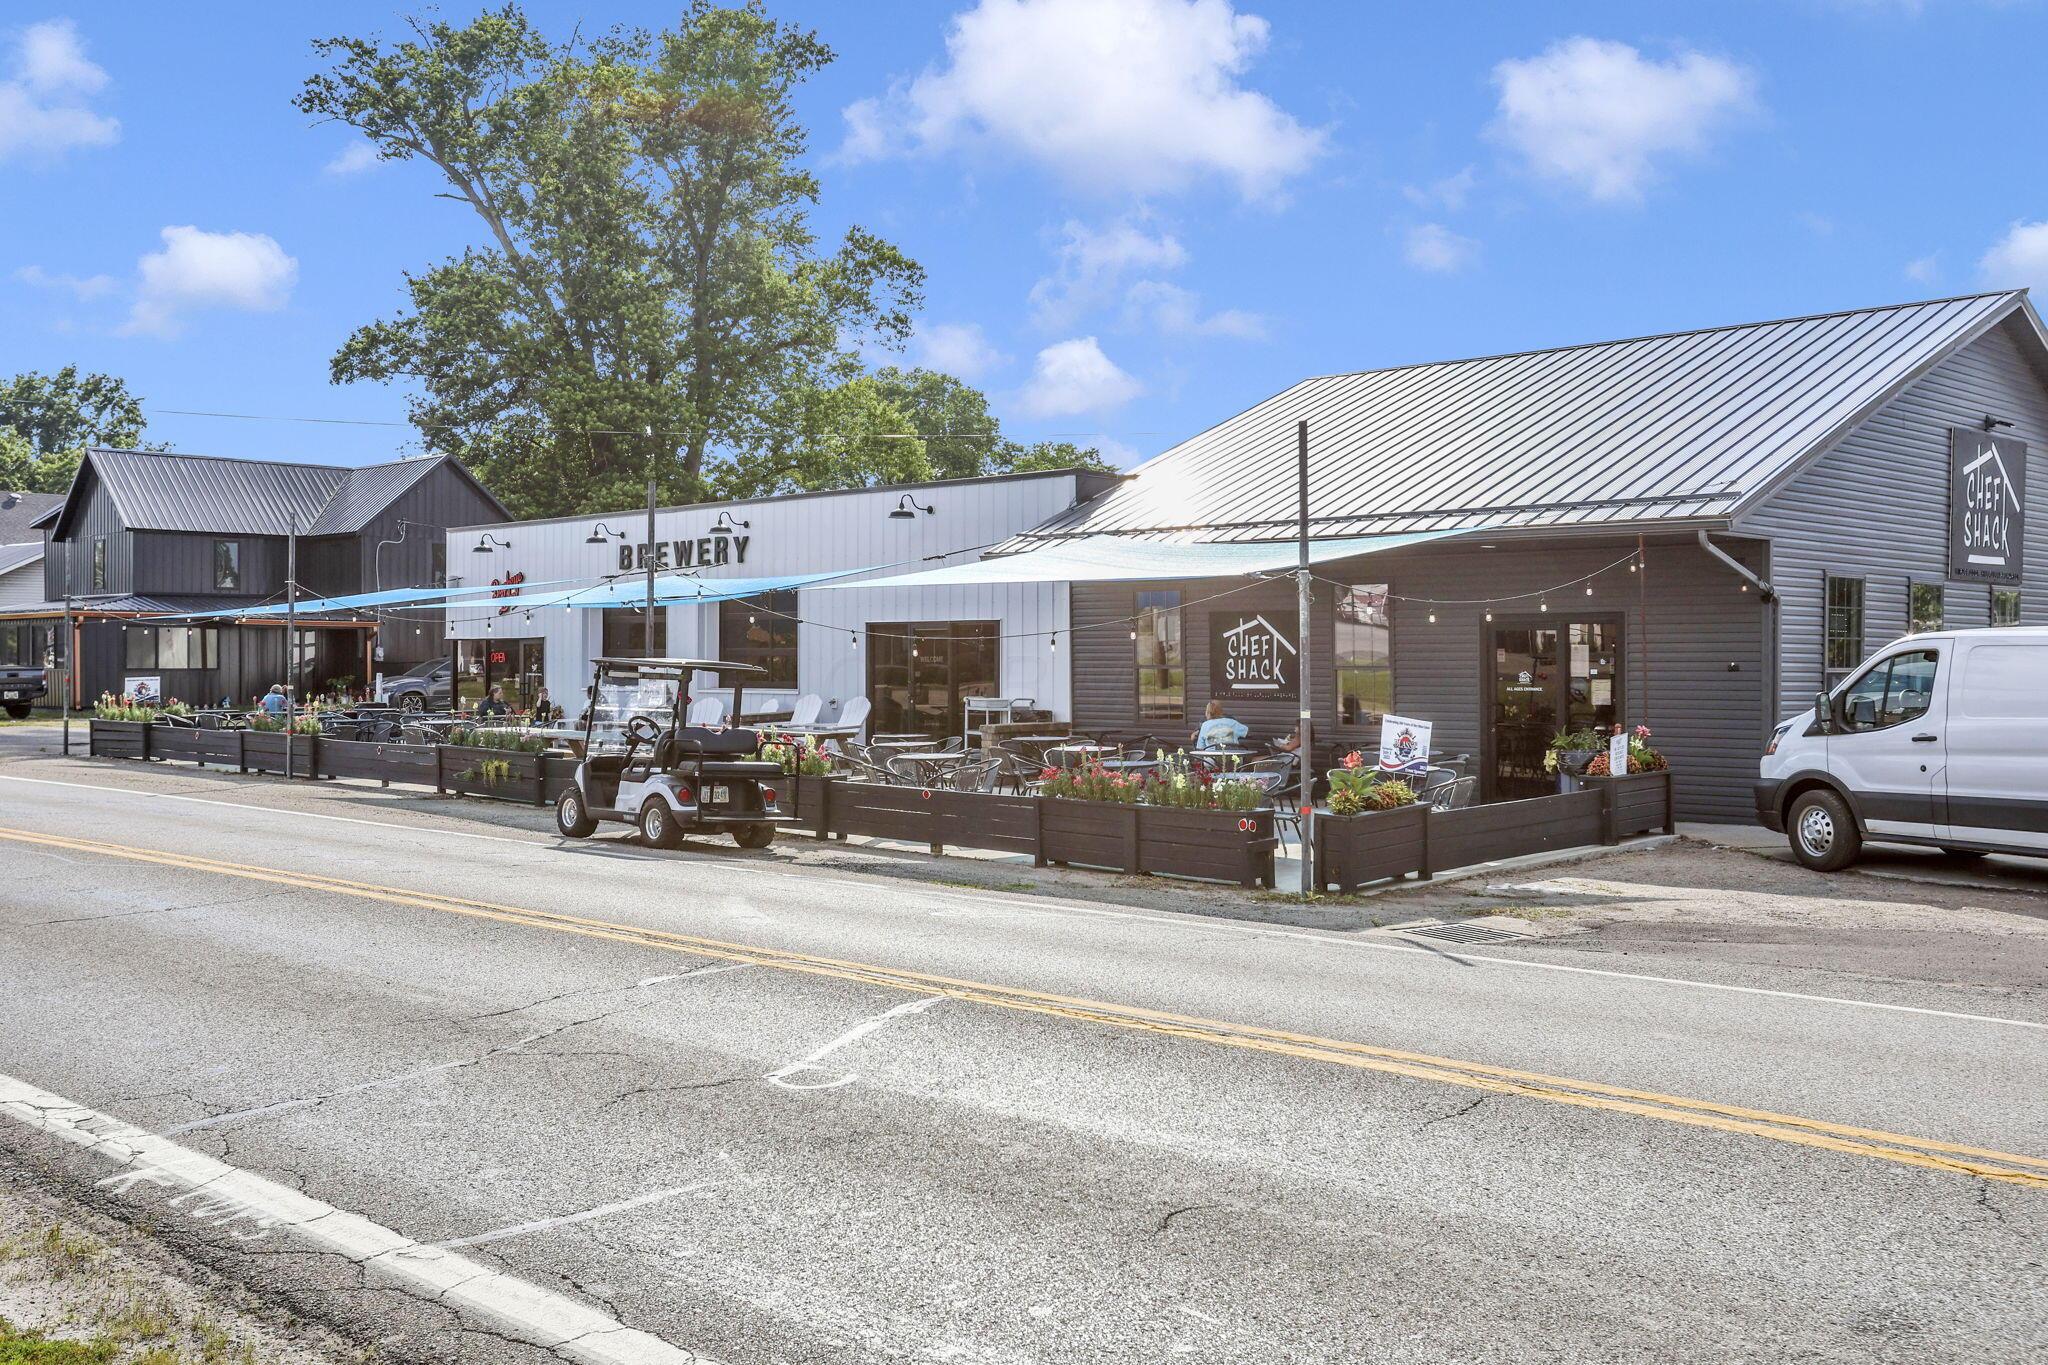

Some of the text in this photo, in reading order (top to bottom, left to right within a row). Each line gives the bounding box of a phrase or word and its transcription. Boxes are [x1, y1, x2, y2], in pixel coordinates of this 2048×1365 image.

[1966, 465, 2001, 511] CHEF
[1964, 502, 2010, 557] SHACK
[619, 536, 750, 570] BREWERY
[490, 652, 506, 663] OPEN
[1227, 628, 1270, 657] CHEF
[1225, 650, 1286, 684] SHACK
